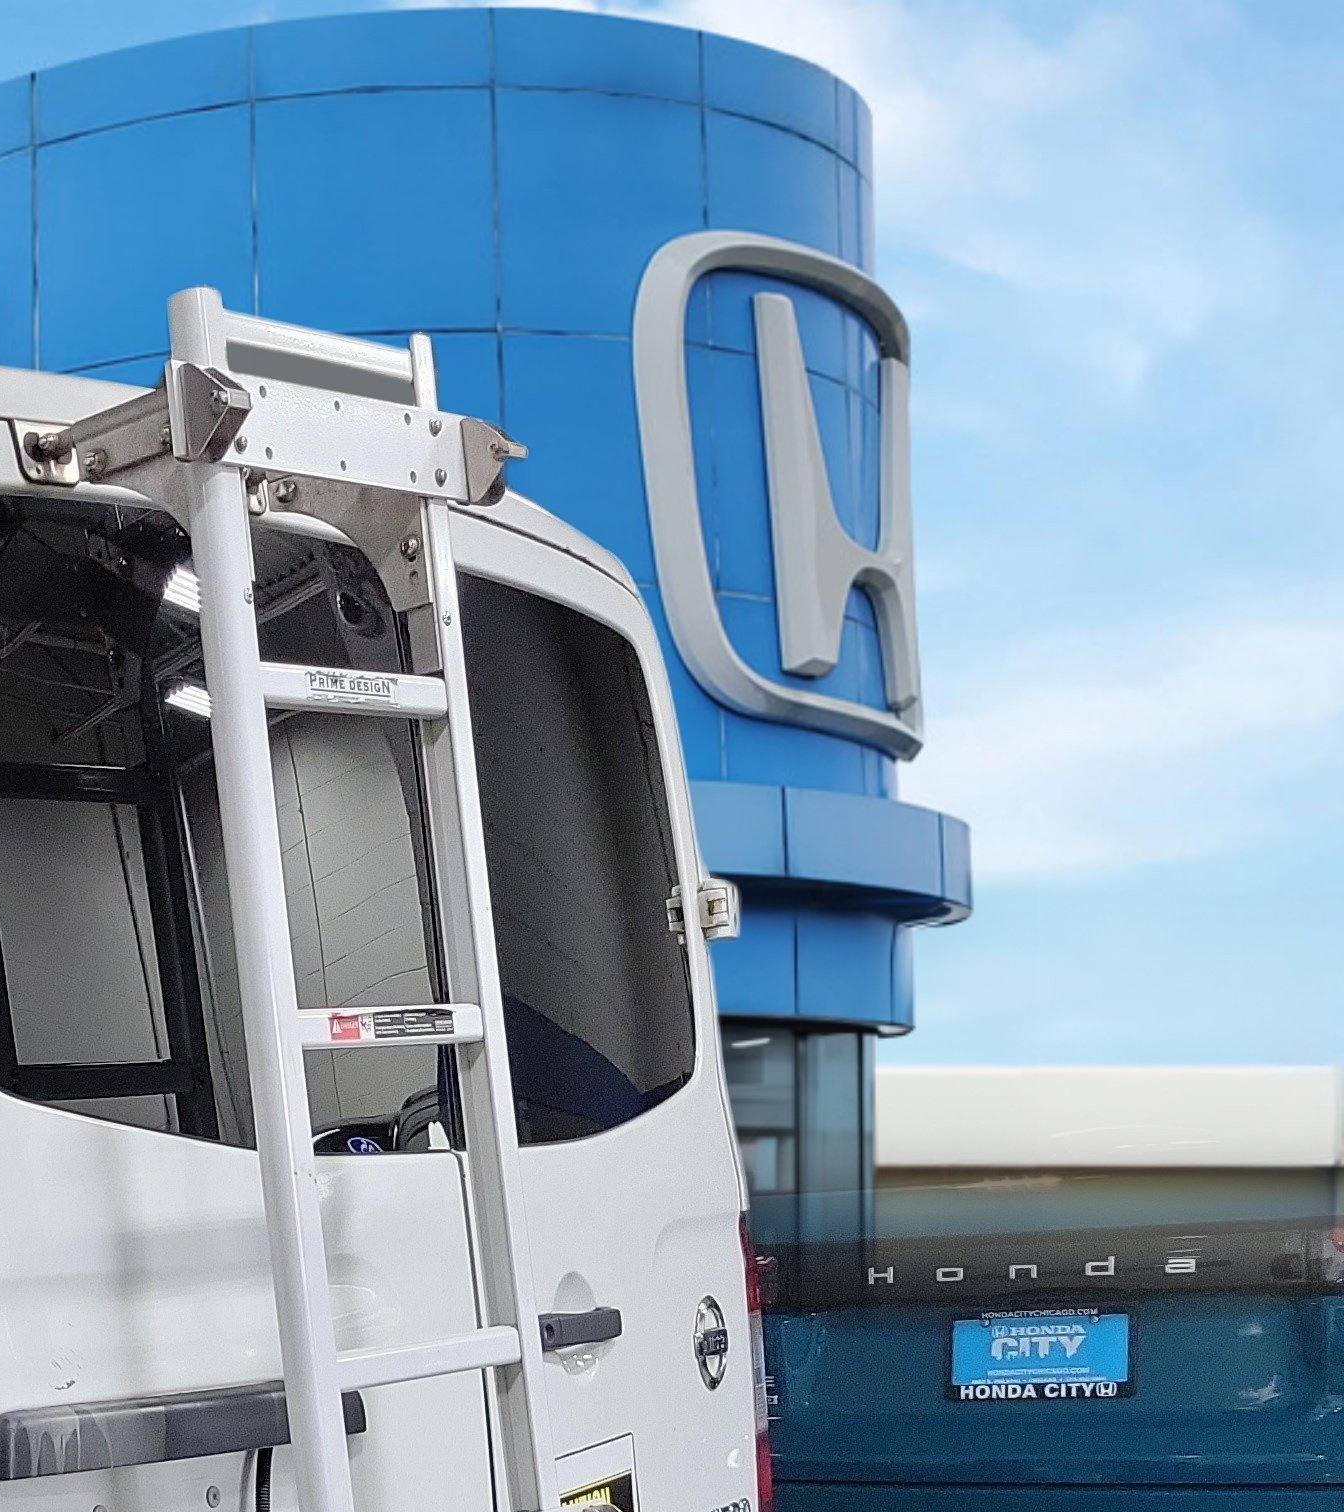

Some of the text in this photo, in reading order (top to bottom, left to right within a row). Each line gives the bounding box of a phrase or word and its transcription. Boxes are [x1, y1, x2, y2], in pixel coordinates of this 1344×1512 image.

[310, 673, 391, 693] PRIME DESIGN
[1009, 1324, 1086, 1336] HONDA
[990, 1336, 1087, 1361] CITY
[960, 1382, 1096, 1400] HONDA CITY
